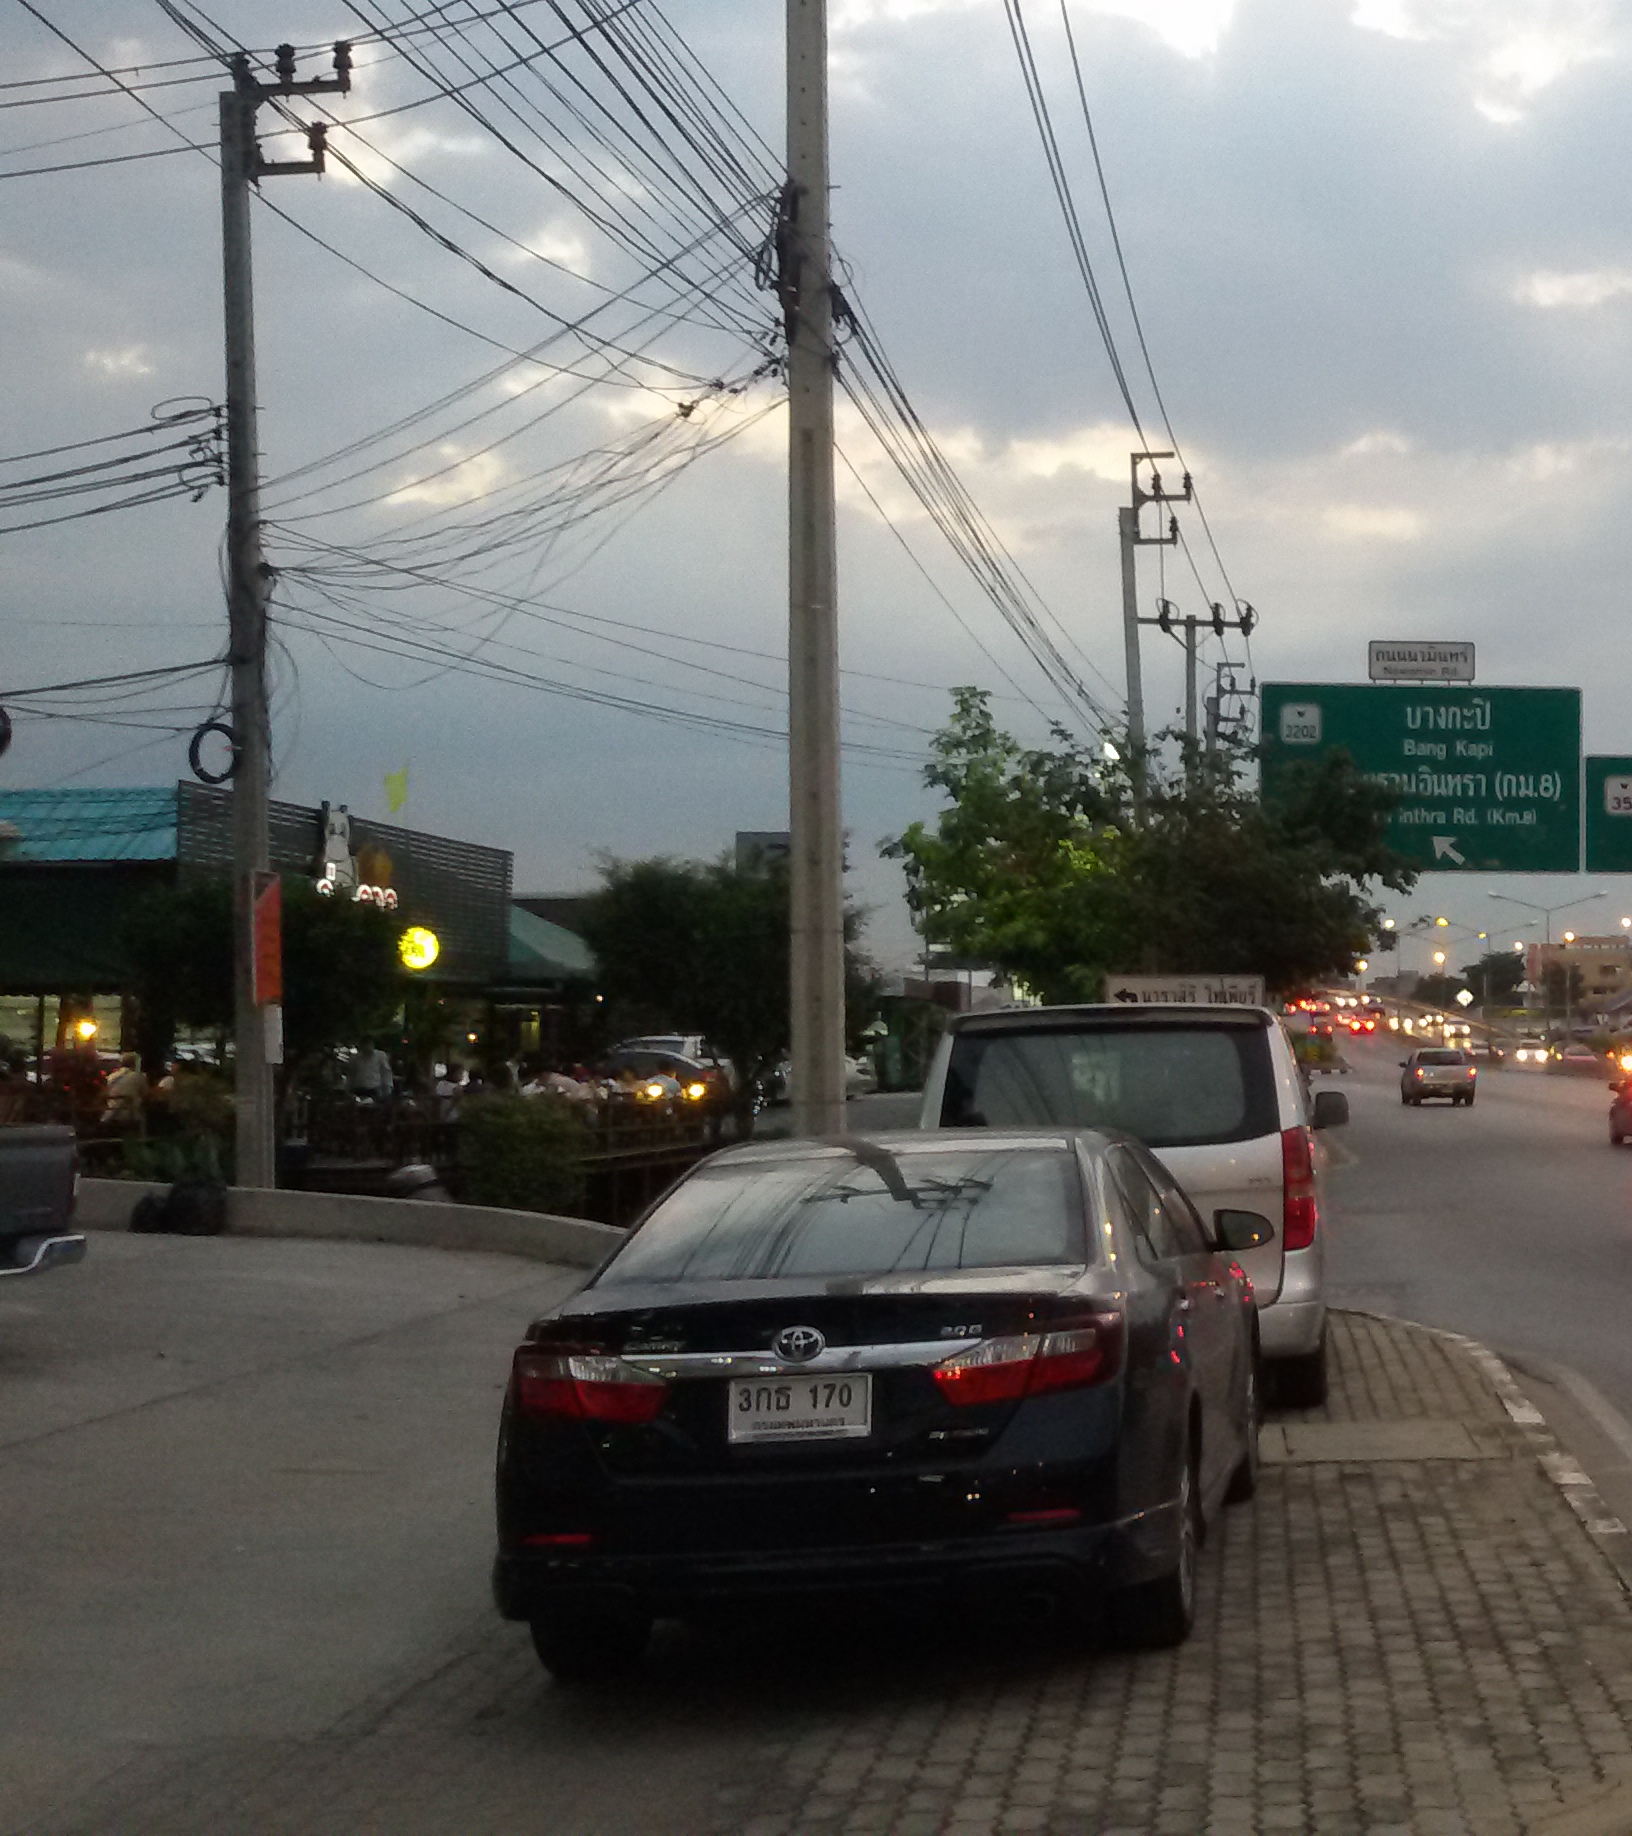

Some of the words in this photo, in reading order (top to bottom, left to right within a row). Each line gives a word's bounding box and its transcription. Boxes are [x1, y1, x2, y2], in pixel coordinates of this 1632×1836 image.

[1406, 698, 1492, 730] บางกะปิ
[1285, 724, 1317, 739] 3202
[1403, 738, 1447, 760] Bang
[1455, 739, 1494, 760] Kapi
[1493, 770, 1562, 801] (กม.8)
[808, 1383, 853, 1409] 170
